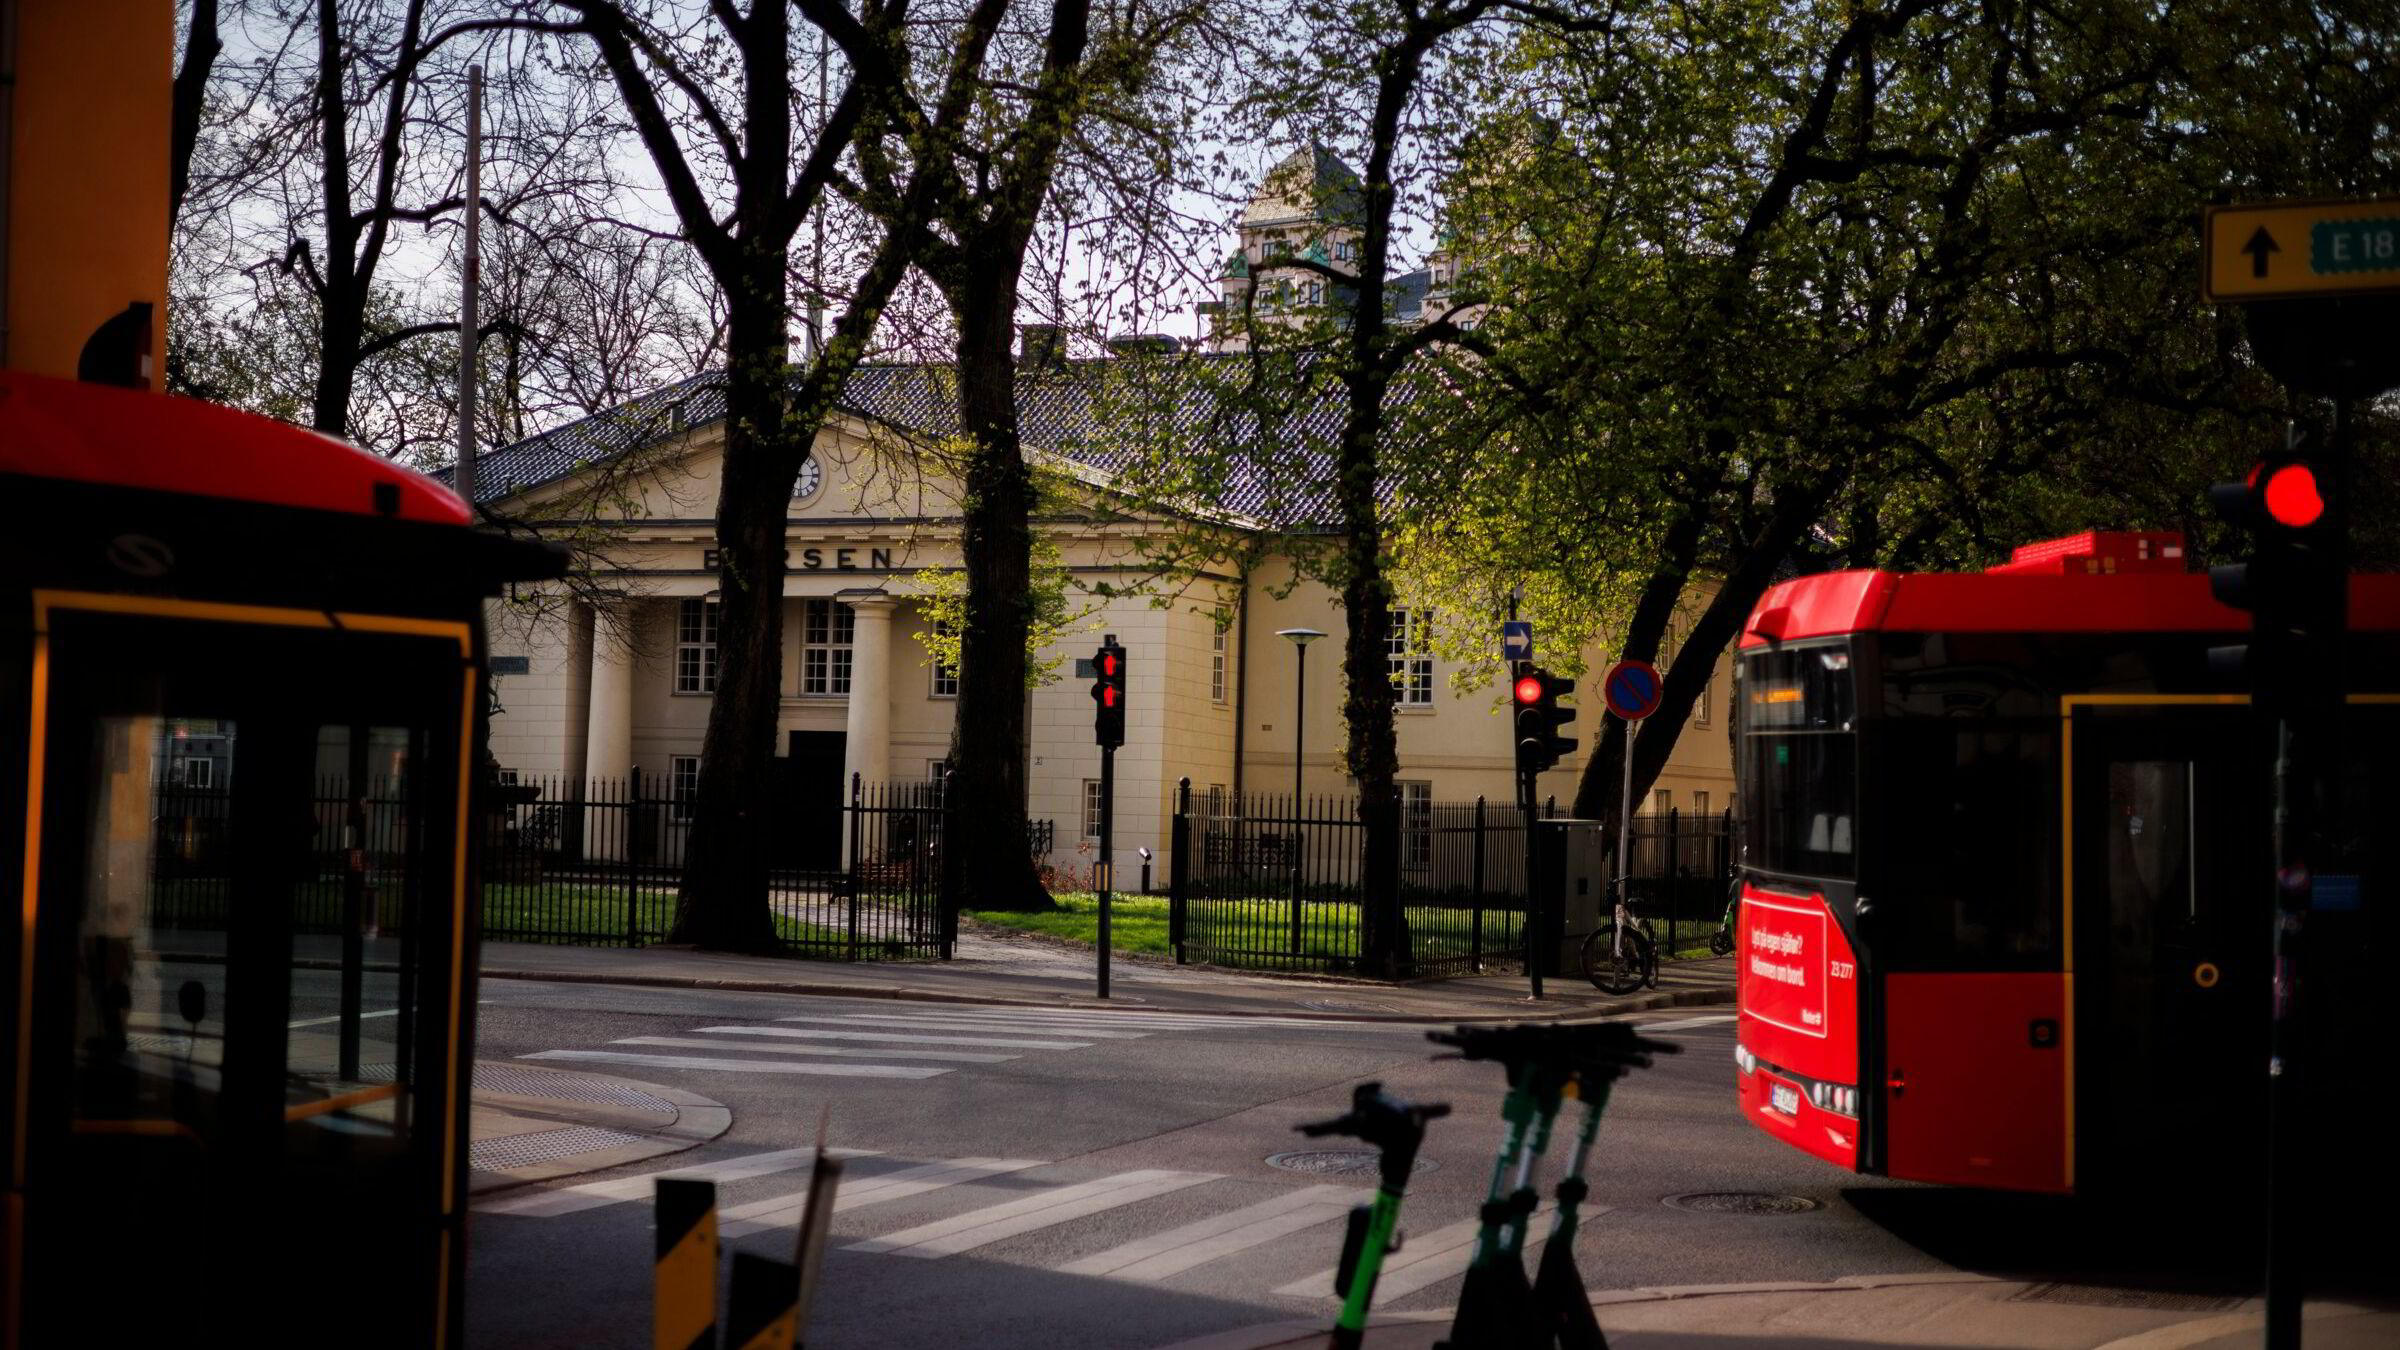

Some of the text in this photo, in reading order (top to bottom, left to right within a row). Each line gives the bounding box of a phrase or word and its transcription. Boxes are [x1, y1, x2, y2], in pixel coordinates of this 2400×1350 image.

[2332, 230, 2395, 261] E 18
[704, 549, 890, 570] BSEN
